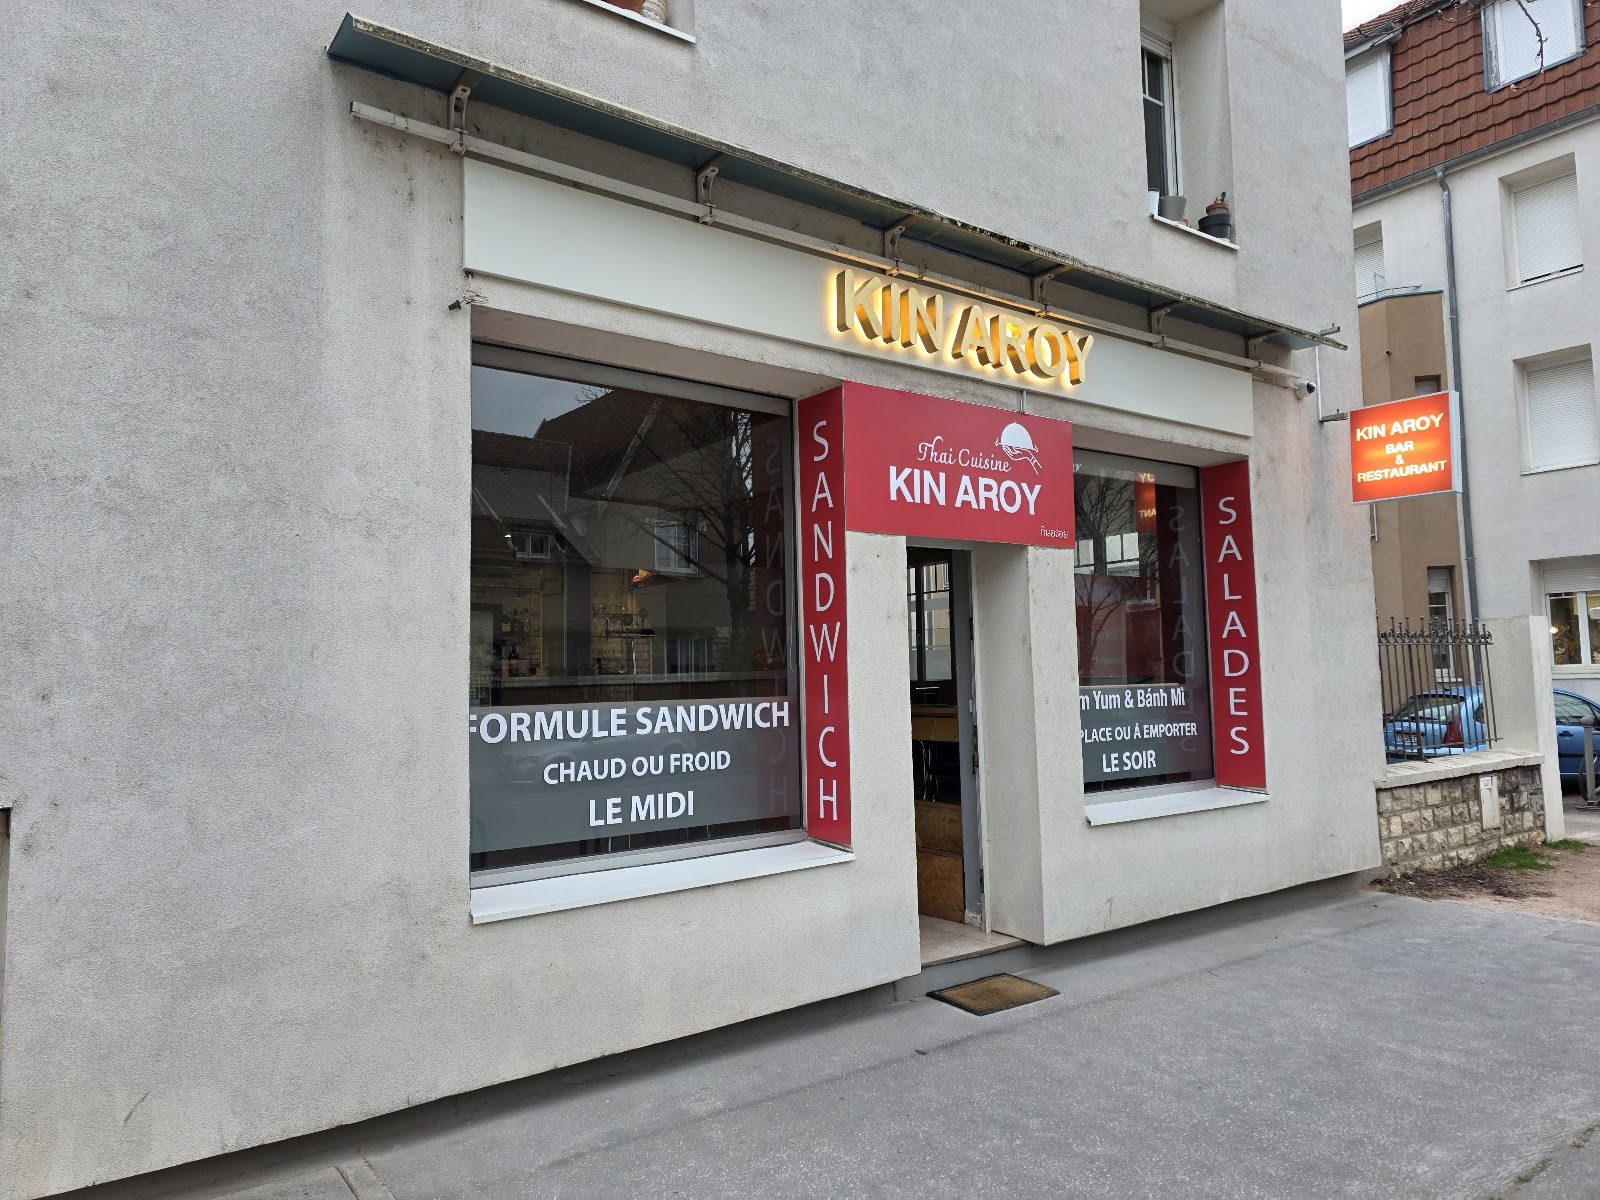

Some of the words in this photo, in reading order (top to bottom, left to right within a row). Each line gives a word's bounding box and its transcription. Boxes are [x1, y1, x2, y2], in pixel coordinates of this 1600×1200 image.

[836, 269, 944, 354] KIN
[951, 304, 1094, 386] AROY
[1356, 423, 1386, 442] KIN
[1390, 413, 1444, 436] AROY
[917, 435, 956, 465] Thai
[958, 448, 1012, 473] Cuisine
[1385, 440, 1414, 455] BAR
[1395, 454, 1405, 465] &
[1357, 460, 1447, 483] RESTAURANT
[889, 465, 946, 506] KIN
[954, 474, 1042, 516] AROY
[809, 420, 841, 821] SANDWICH
[1217, 496, 1250, 755] SALADES
[1092, 690, 1121, 710] Yum
[1124, 689, 1135, 709] &
[1137, 688, 1168, 708] Bánh
[636, 701, 789, 735] SANDWICH
[1114, 725, 1131, 741] OU
[1143, 723, 1198, 739] EMPORTER
[543, 757, 626, 785] CHAUD
[631, 755, 663, 777] OU
[669, 750, 731, 773] FROID
[1102, 753, 1119, 773] LE
[1123, 750, 1157, 771] SOIR
[589, 797, 622, 827] LE
[630, 790, 694, 822] MIDI
